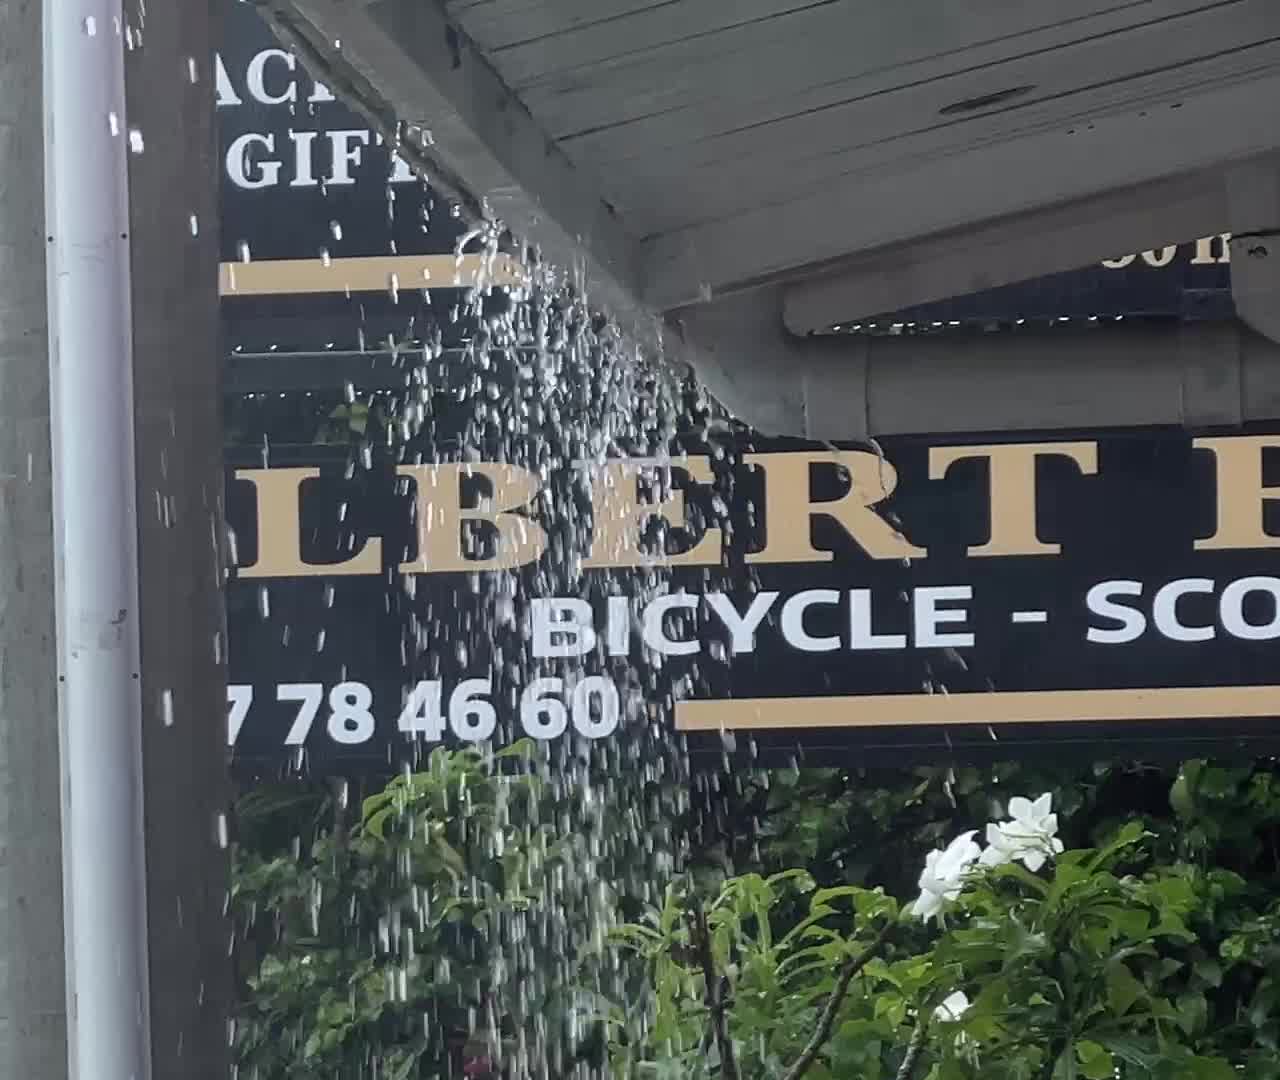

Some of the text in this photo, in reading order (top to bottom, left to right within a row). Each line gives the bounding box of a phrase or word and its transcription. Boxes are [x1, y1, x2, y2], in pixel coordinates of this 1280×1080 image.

[530, 584, 976, 658] BICYCLE
[1086, 575, 1280, 644] SCO
[276, 680, 376, 745] 78
[397, 678, 497, 743] 46
[520, 675, 620, 740] 60
